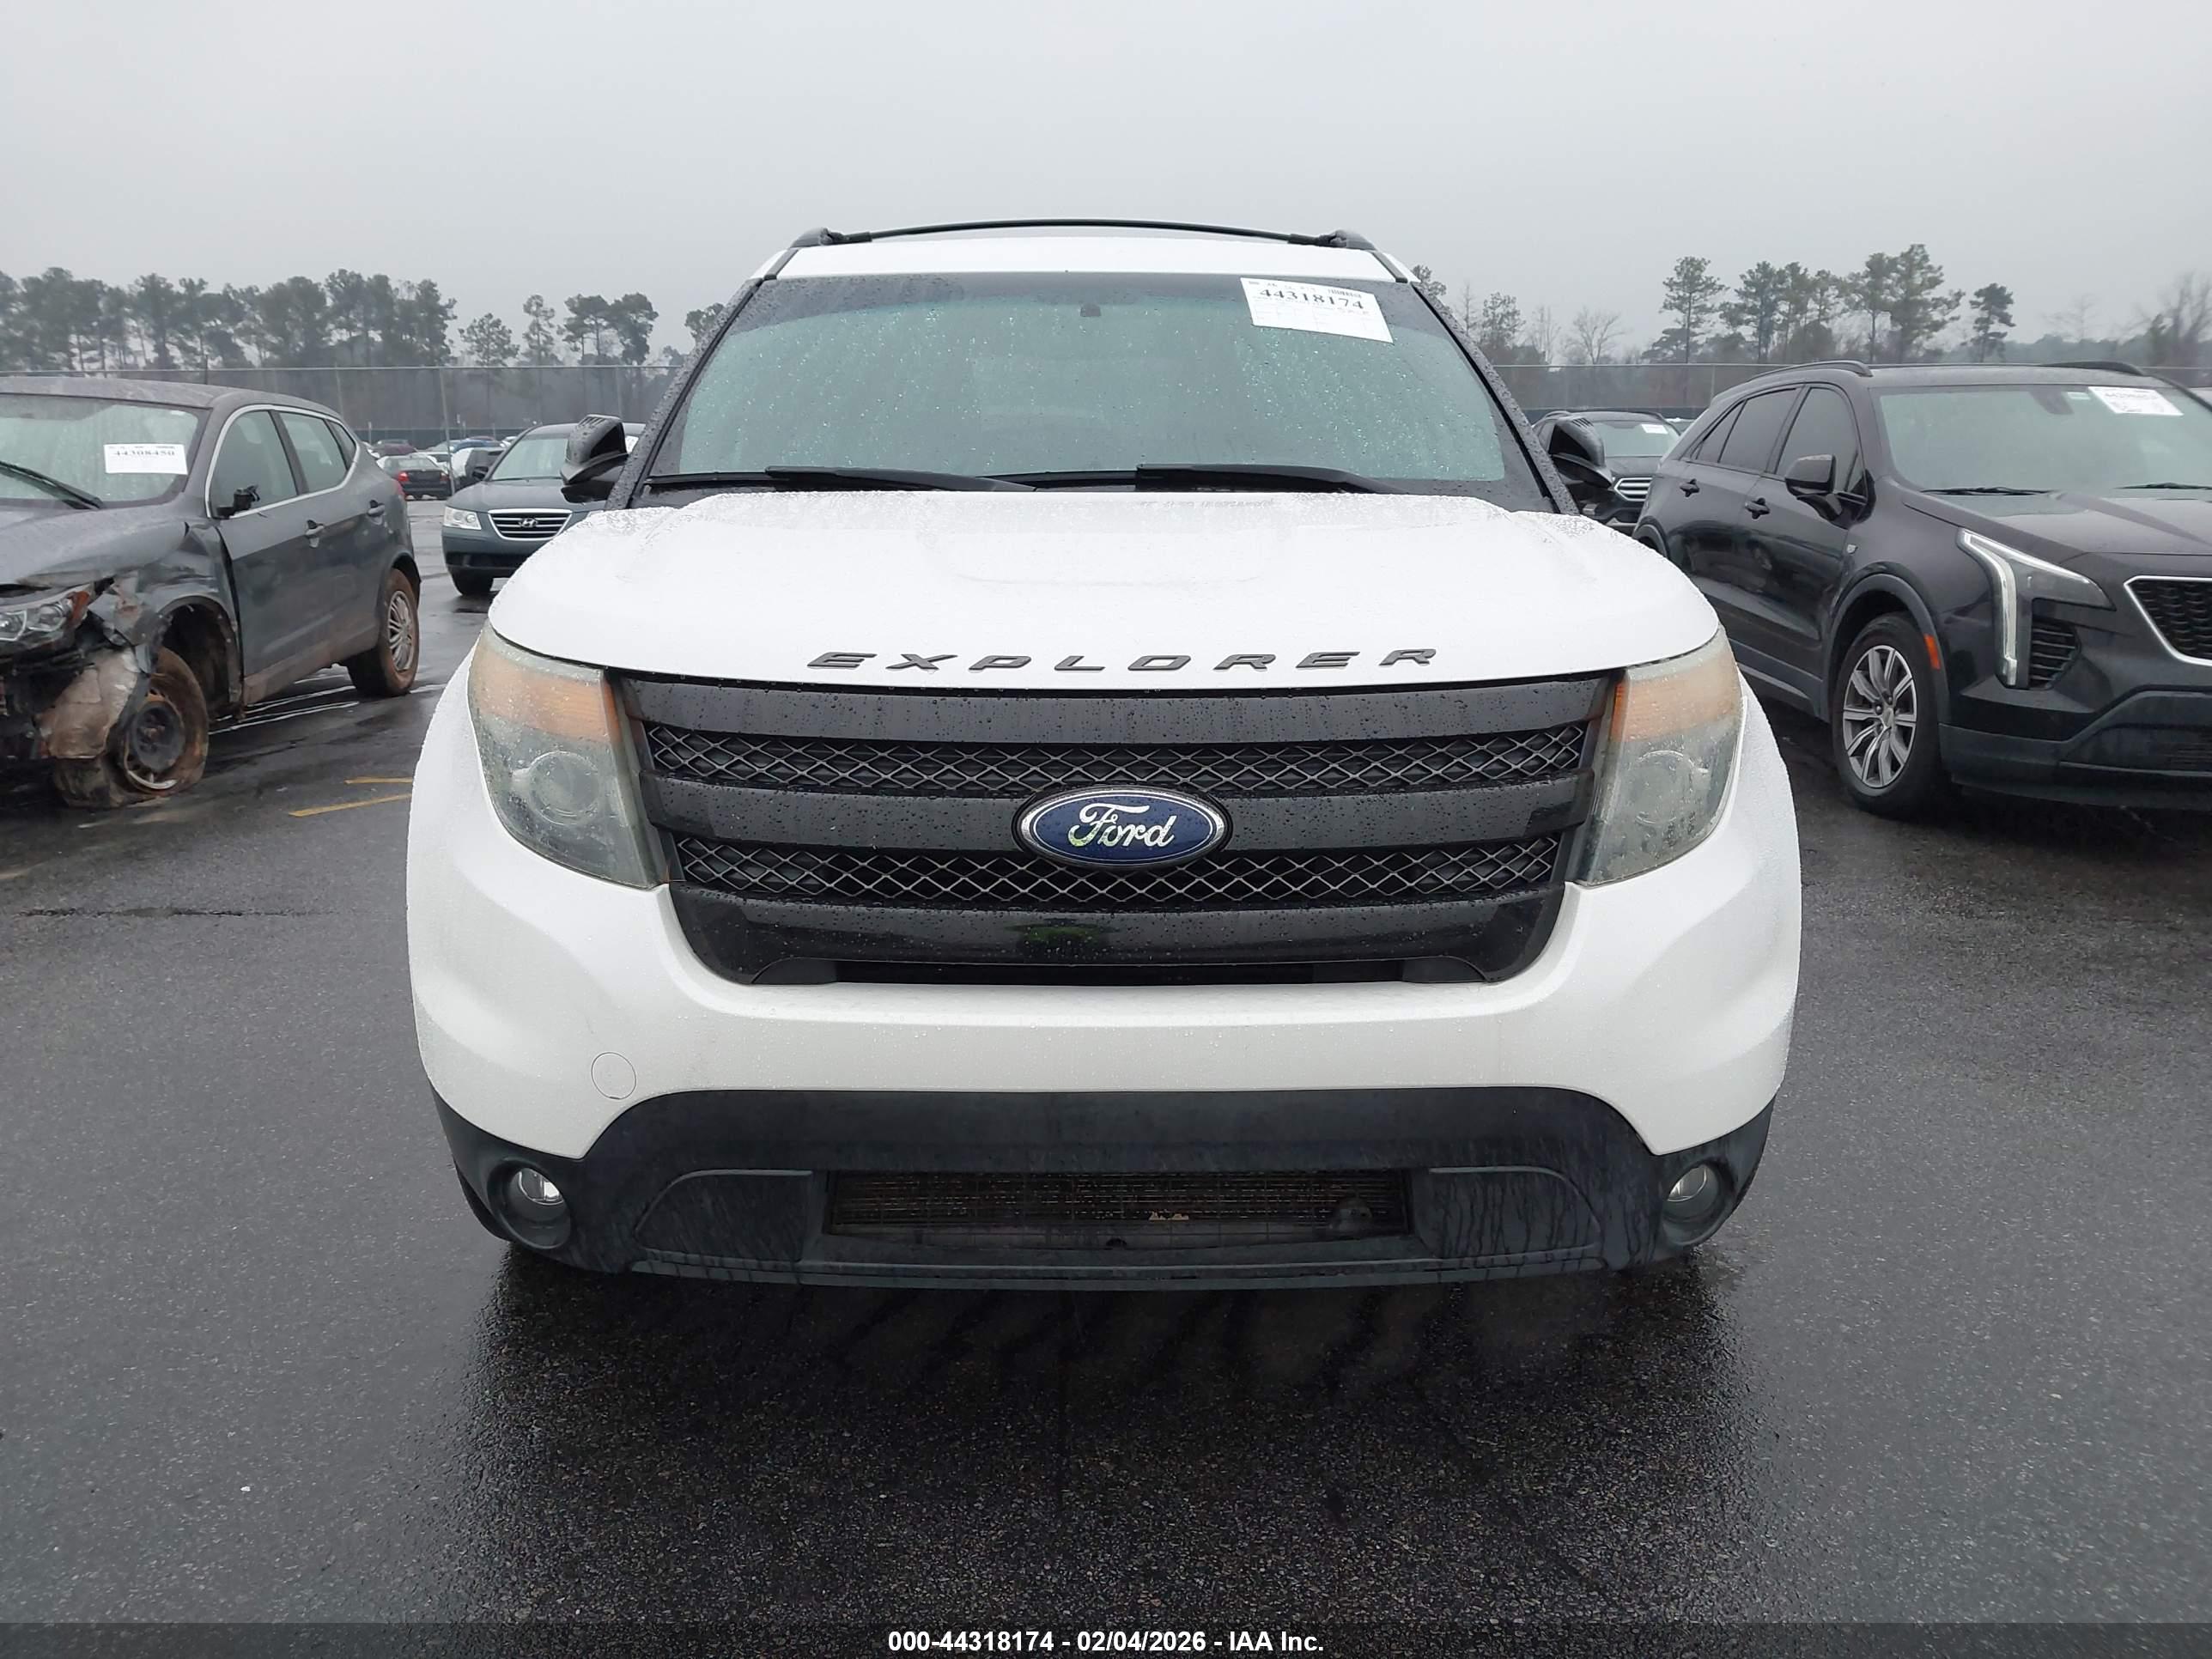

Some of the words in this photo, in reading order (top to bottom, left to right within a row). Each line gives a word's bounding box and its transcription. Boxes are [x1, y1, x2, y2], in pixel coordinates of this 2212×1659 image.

[1259, 289, 1364, 310] 44318174
[806, 647, 1437, 672] EXPLORER
[1067, 802, 1177, 848] Ford
